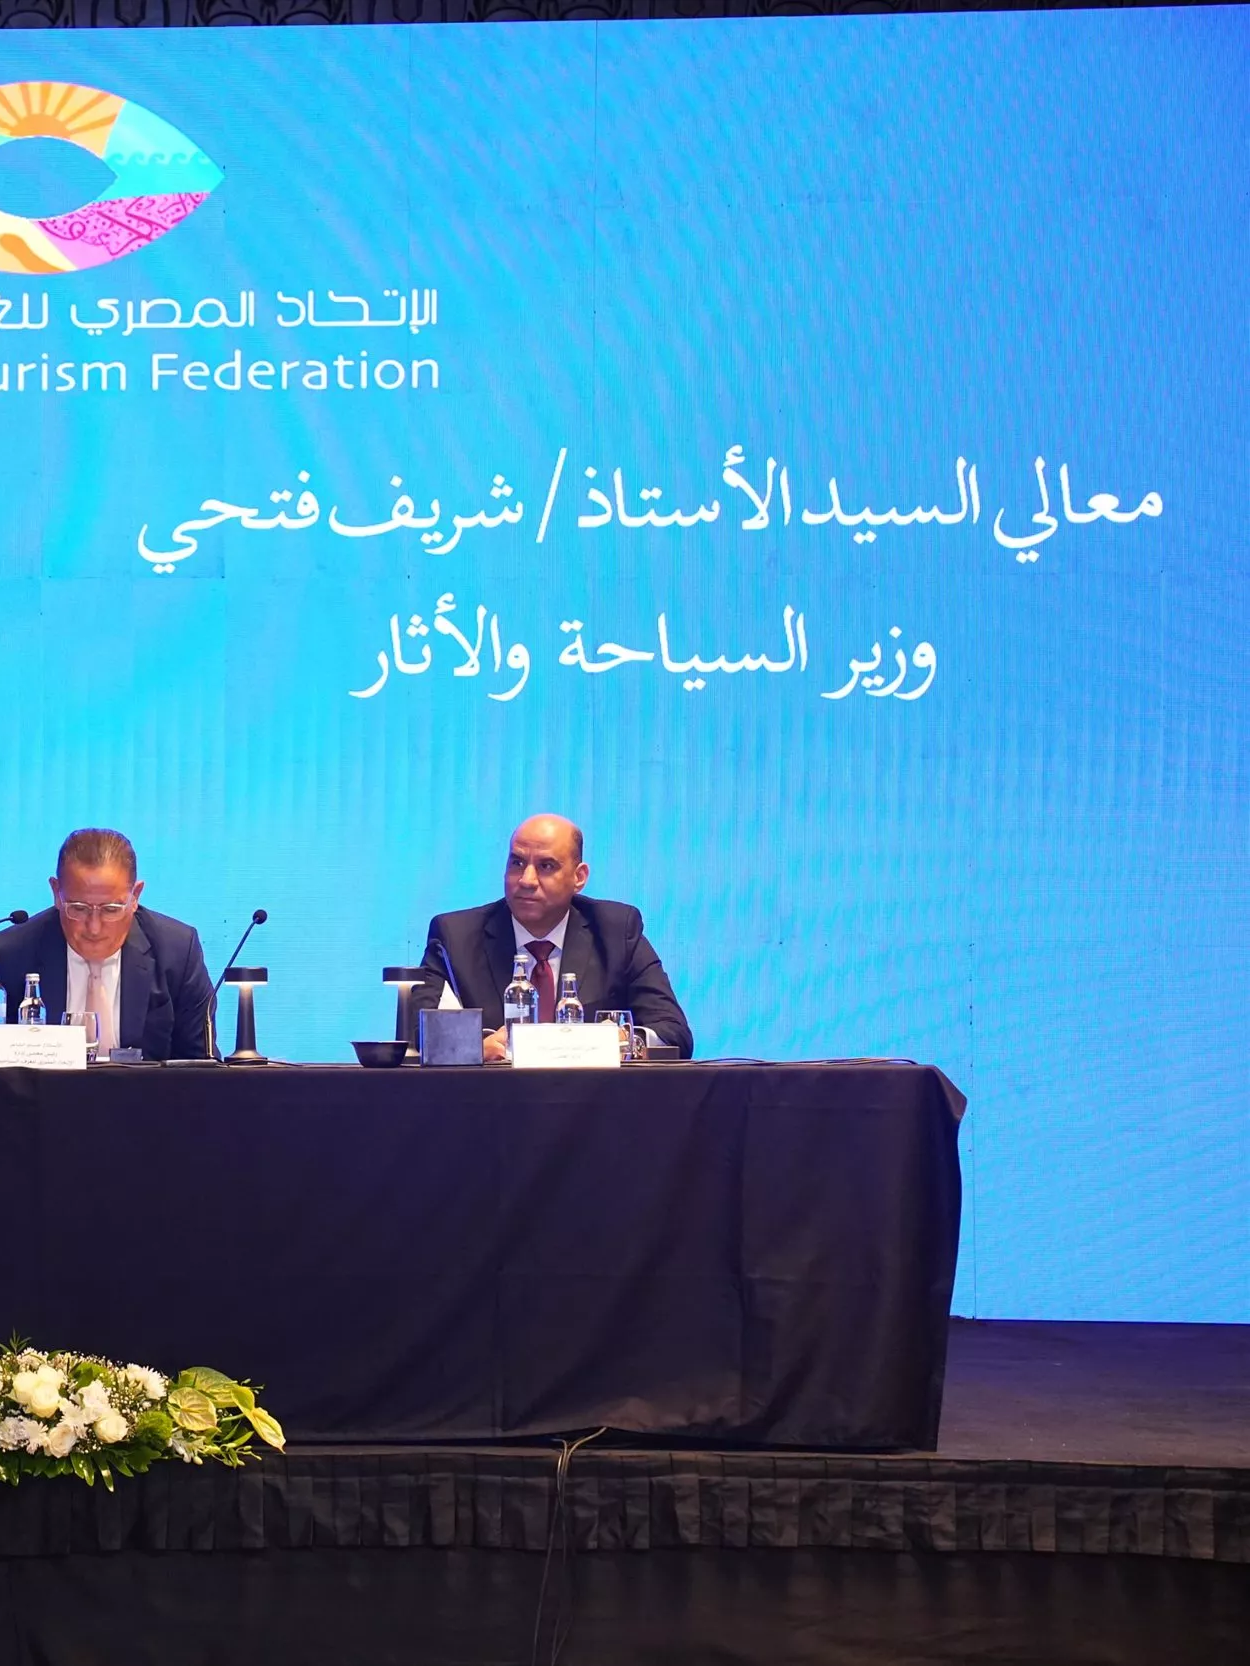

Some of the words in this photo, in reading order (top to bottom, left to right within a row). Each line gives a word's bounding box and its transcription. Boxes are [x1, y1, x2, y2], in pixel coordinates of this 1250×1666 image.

[70, 291, 255, 337] المصري
[276, 289, 438, 335] الإتحاد
[152, 349, 439, 391] Federation
[137, 470, 320, 574] فتحي
[328, 474, 523, 555] شريف
[802, 456, 981, 544] السيد
[993, 456, 1163, 564] معالي
[349, 592, 530, 701] والأثار
[558, 605, 808, 691] السياحة
[821, 626, 937, 700] وزير
